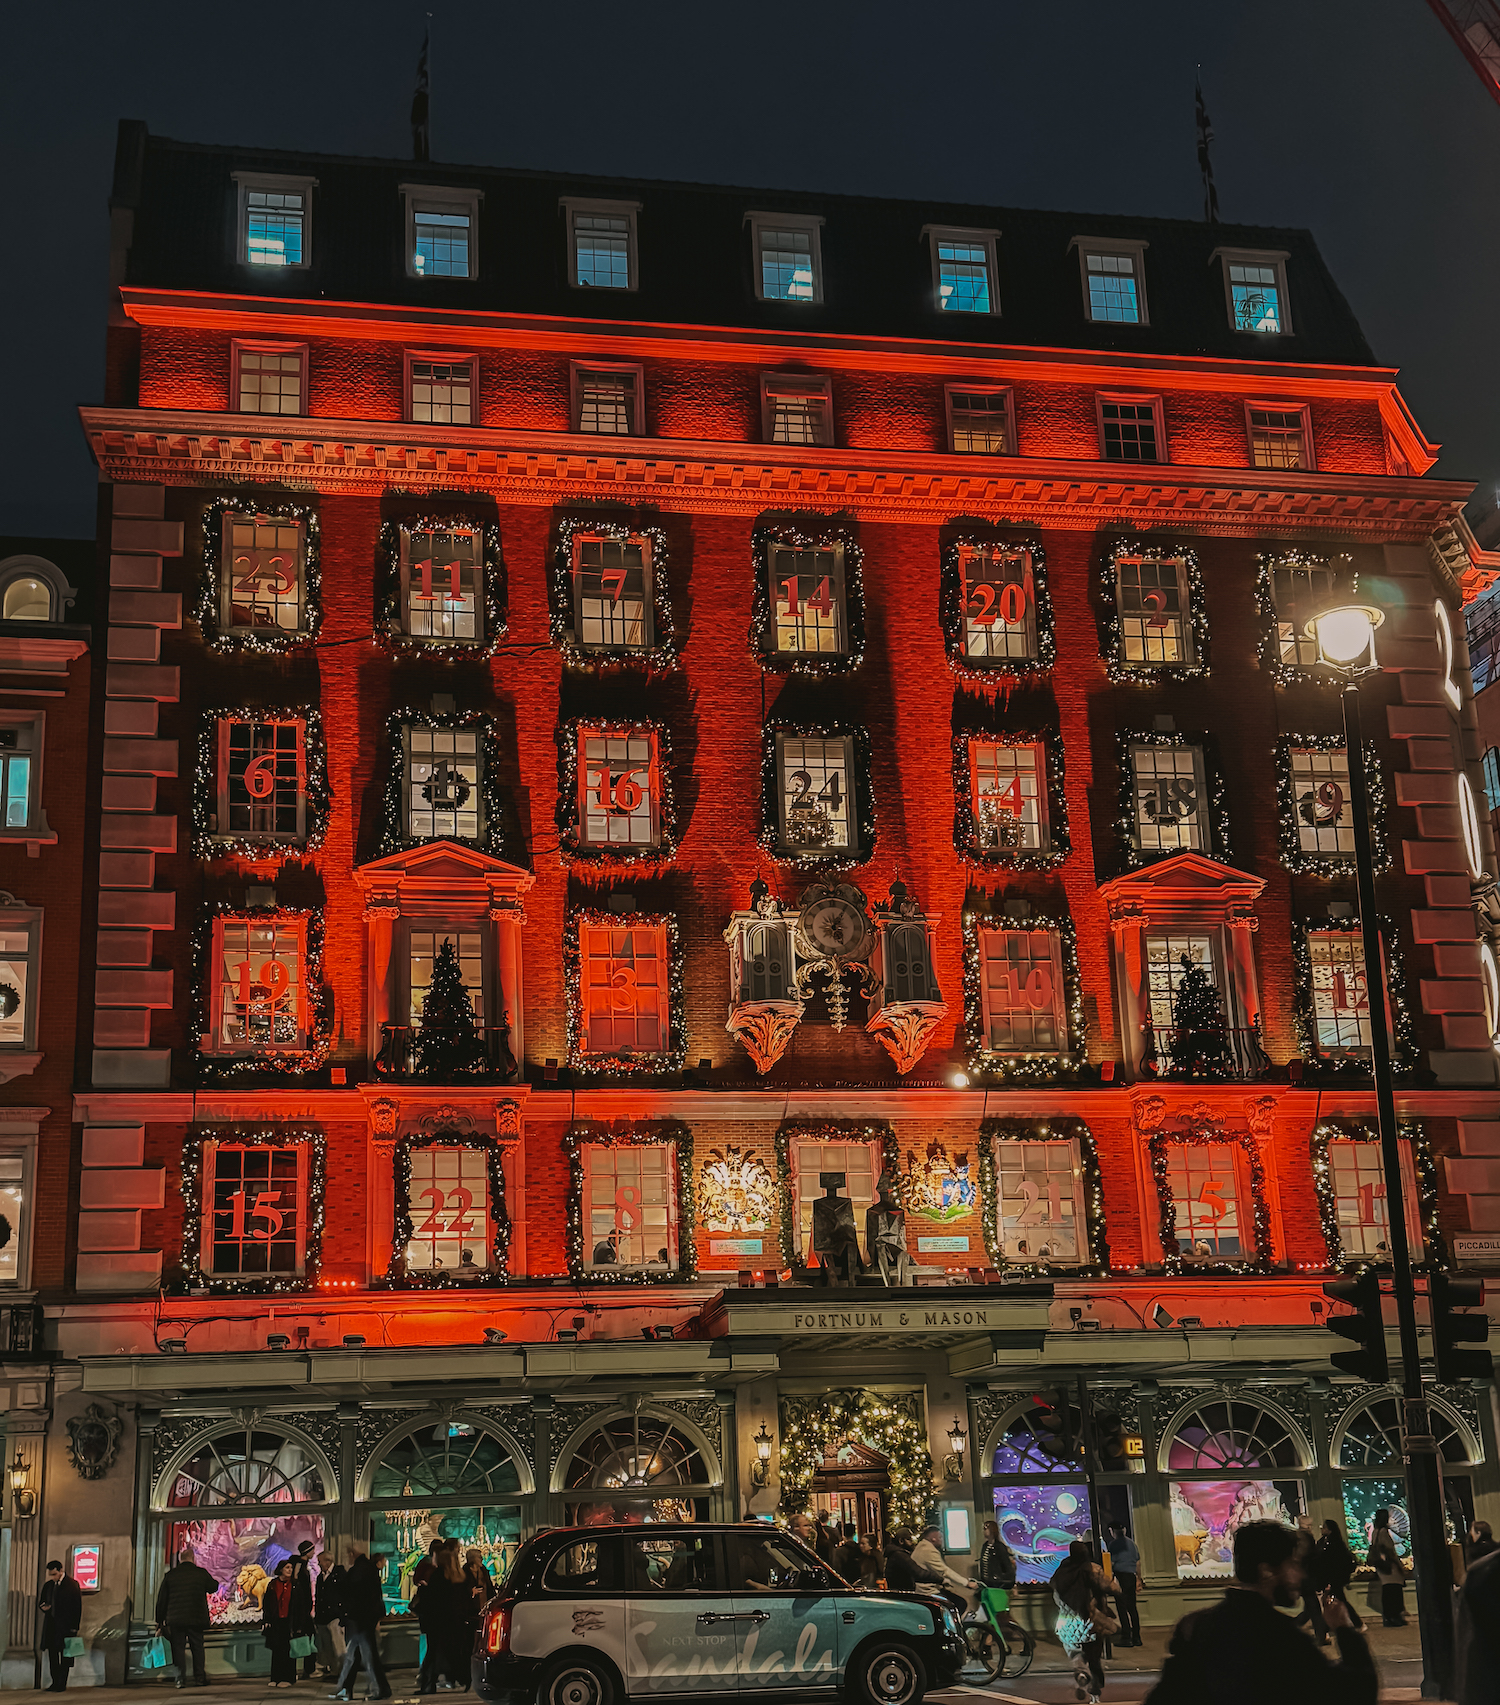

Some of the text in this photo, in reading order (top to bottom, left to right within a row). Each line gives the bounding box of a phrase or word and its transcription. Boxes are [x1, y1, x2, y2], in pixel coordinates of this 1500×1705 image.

[233, 551, 296, 595] 23
[415, 558, 467, 602] 11
[601, 568, 628, 611] 7
[781, 574, 834, 618] 14
[971, 583, 1026, 626] 20
[1143, 589, 1170, 628] 2
[244, 754, 277, 799] 6
[433, 759, 456, 801] 1
[592, 766, 644, 811] 16
[789, 770, 843, 813] 24
[999, 776, 1025, 818] 4
[1153, 777, 1197, 817] 18
[1316, 782, 1344, 822] 9
[232, 959, 290, 1005] 19
[611, 966, 638, 1011] 3
[1000, 967, 1052, 1010] 10
[225, 1190, 284, 1239] 15
[417, 1187, 475, 1232] 22
[614, 1186, 643, 1230] 8
[1014, 1180, 1068, 1224] 21
[1200, 1181, 1228, 1224] 5
[794, 1310, 988, 1328] FORTNUM & MASON
[1127, 1438, 1144, 1455] 02
[627, 1620, 842, 1691] Sandals
[663, 1635, 727, 1646] NEXT STOP
